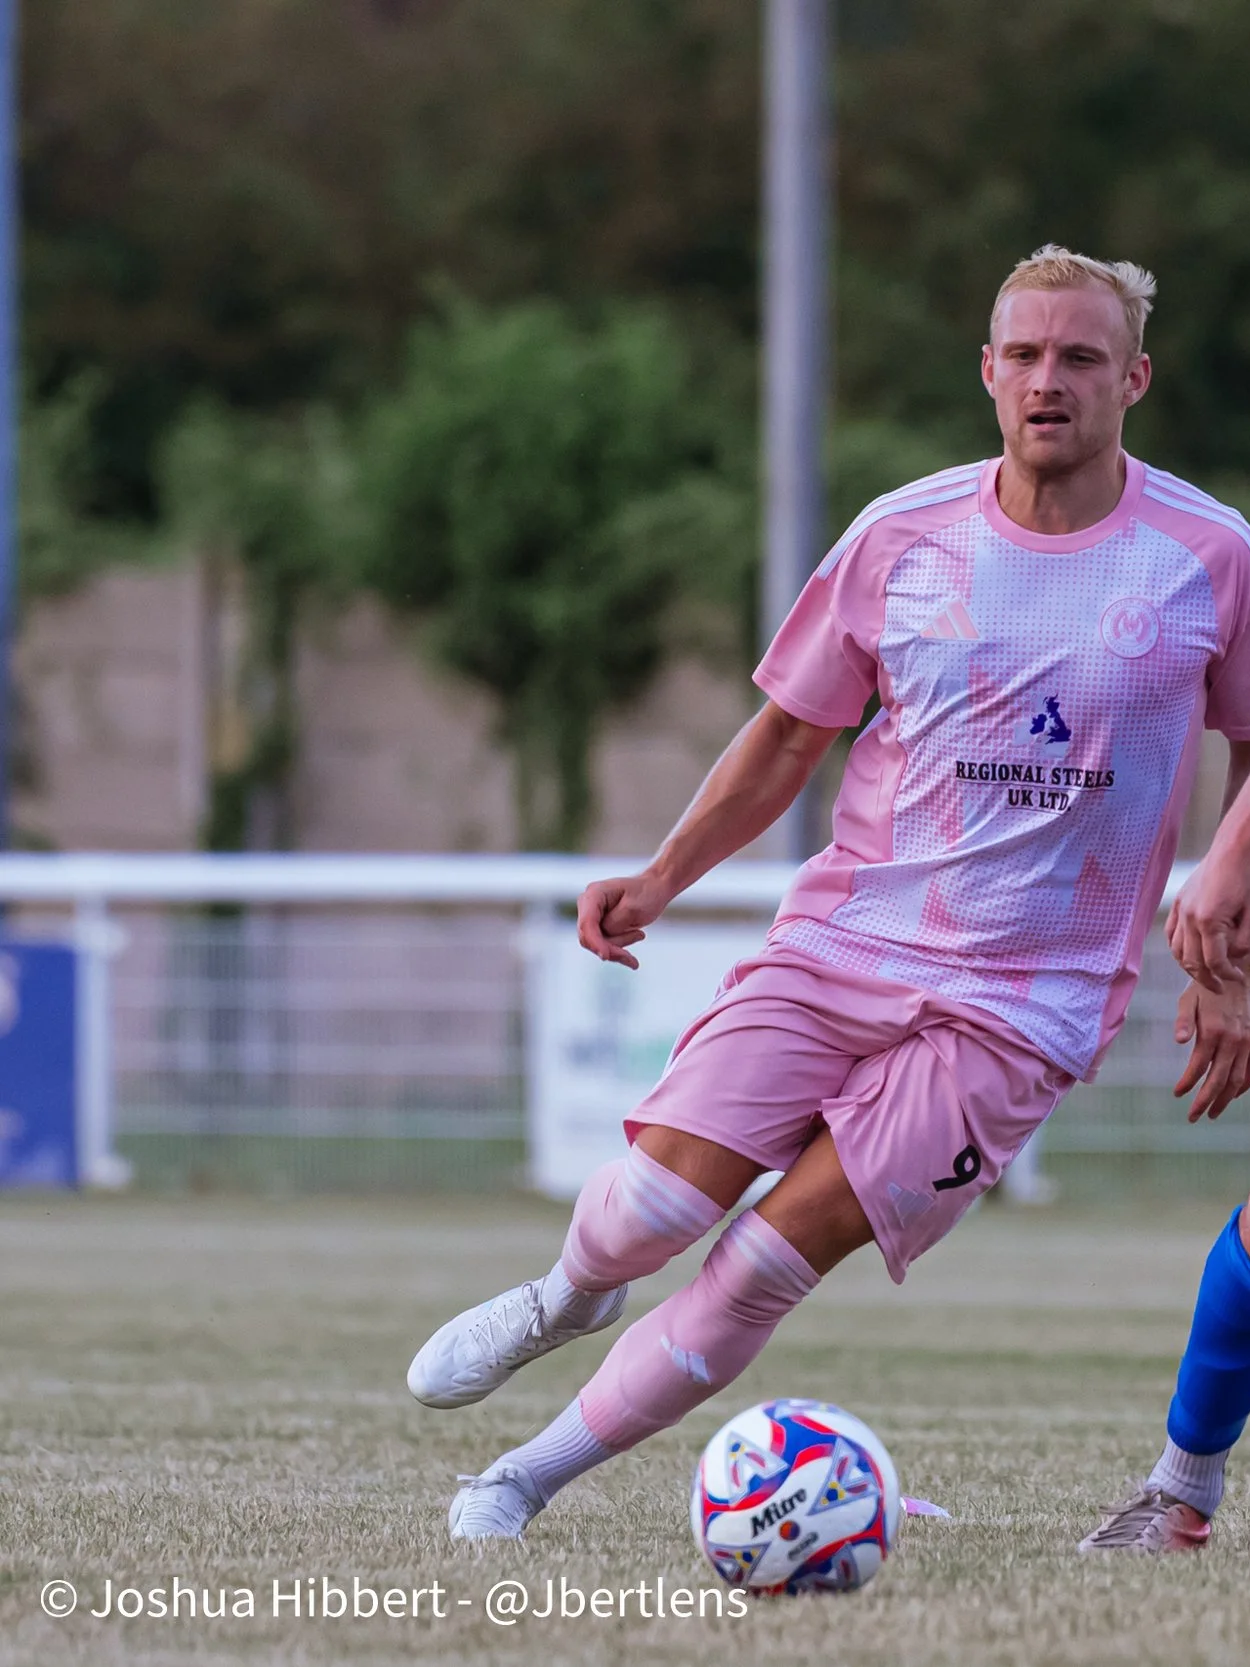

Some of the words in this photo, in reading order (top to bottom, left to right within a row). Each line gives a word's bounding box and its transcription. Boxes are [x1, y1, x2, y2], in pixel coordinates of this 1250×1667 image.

[955, 760, 1046, 784] REGIONAL
[1050, 767, 1115, 788] STEELS
[1008, 789, 1033, 807] UK
[932, 1144, 982, 1192] 9
